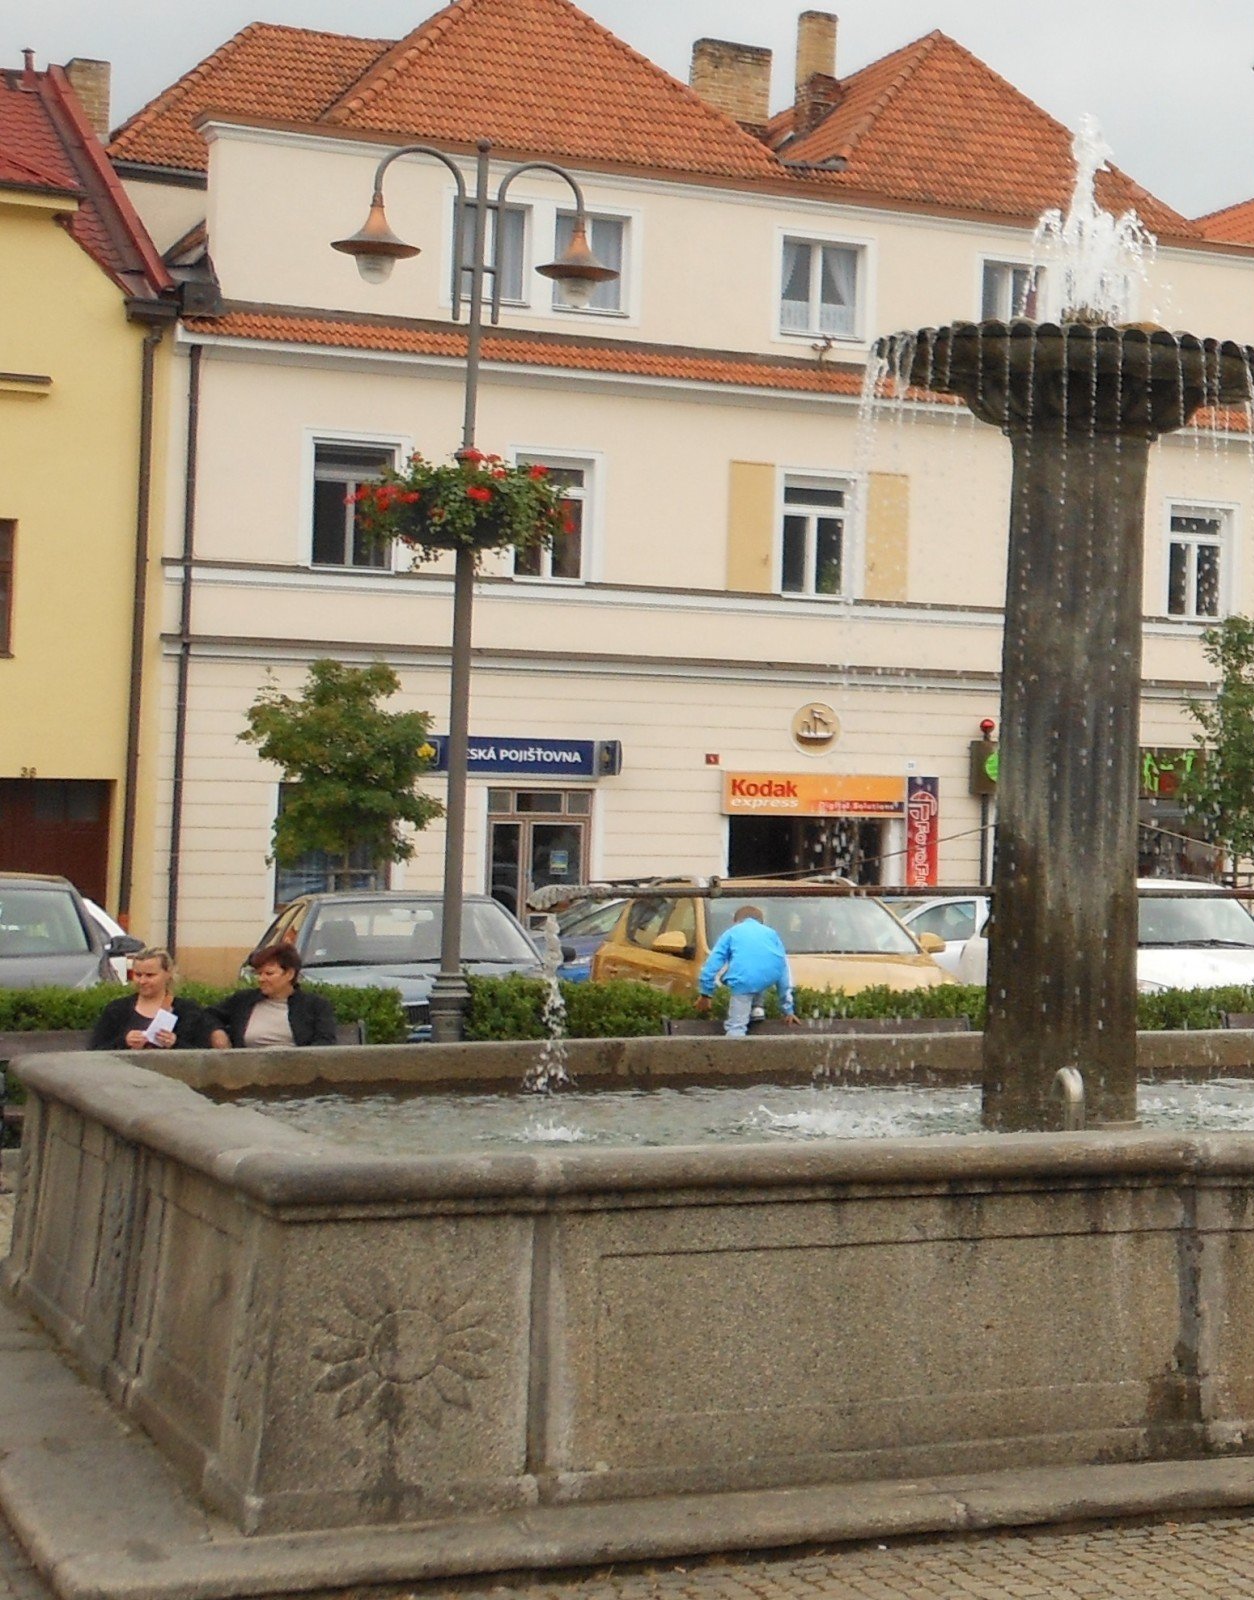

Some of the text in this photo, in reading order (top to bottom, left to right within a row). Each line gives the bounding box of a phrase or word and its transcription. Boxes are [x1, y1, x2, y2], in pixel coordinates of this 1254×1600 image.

[466, 747, 582, 763] SKÁ POJIŠŤOVNA
[731, 779, 798, 797] Kodak
[730, 797, 799, 809] express
